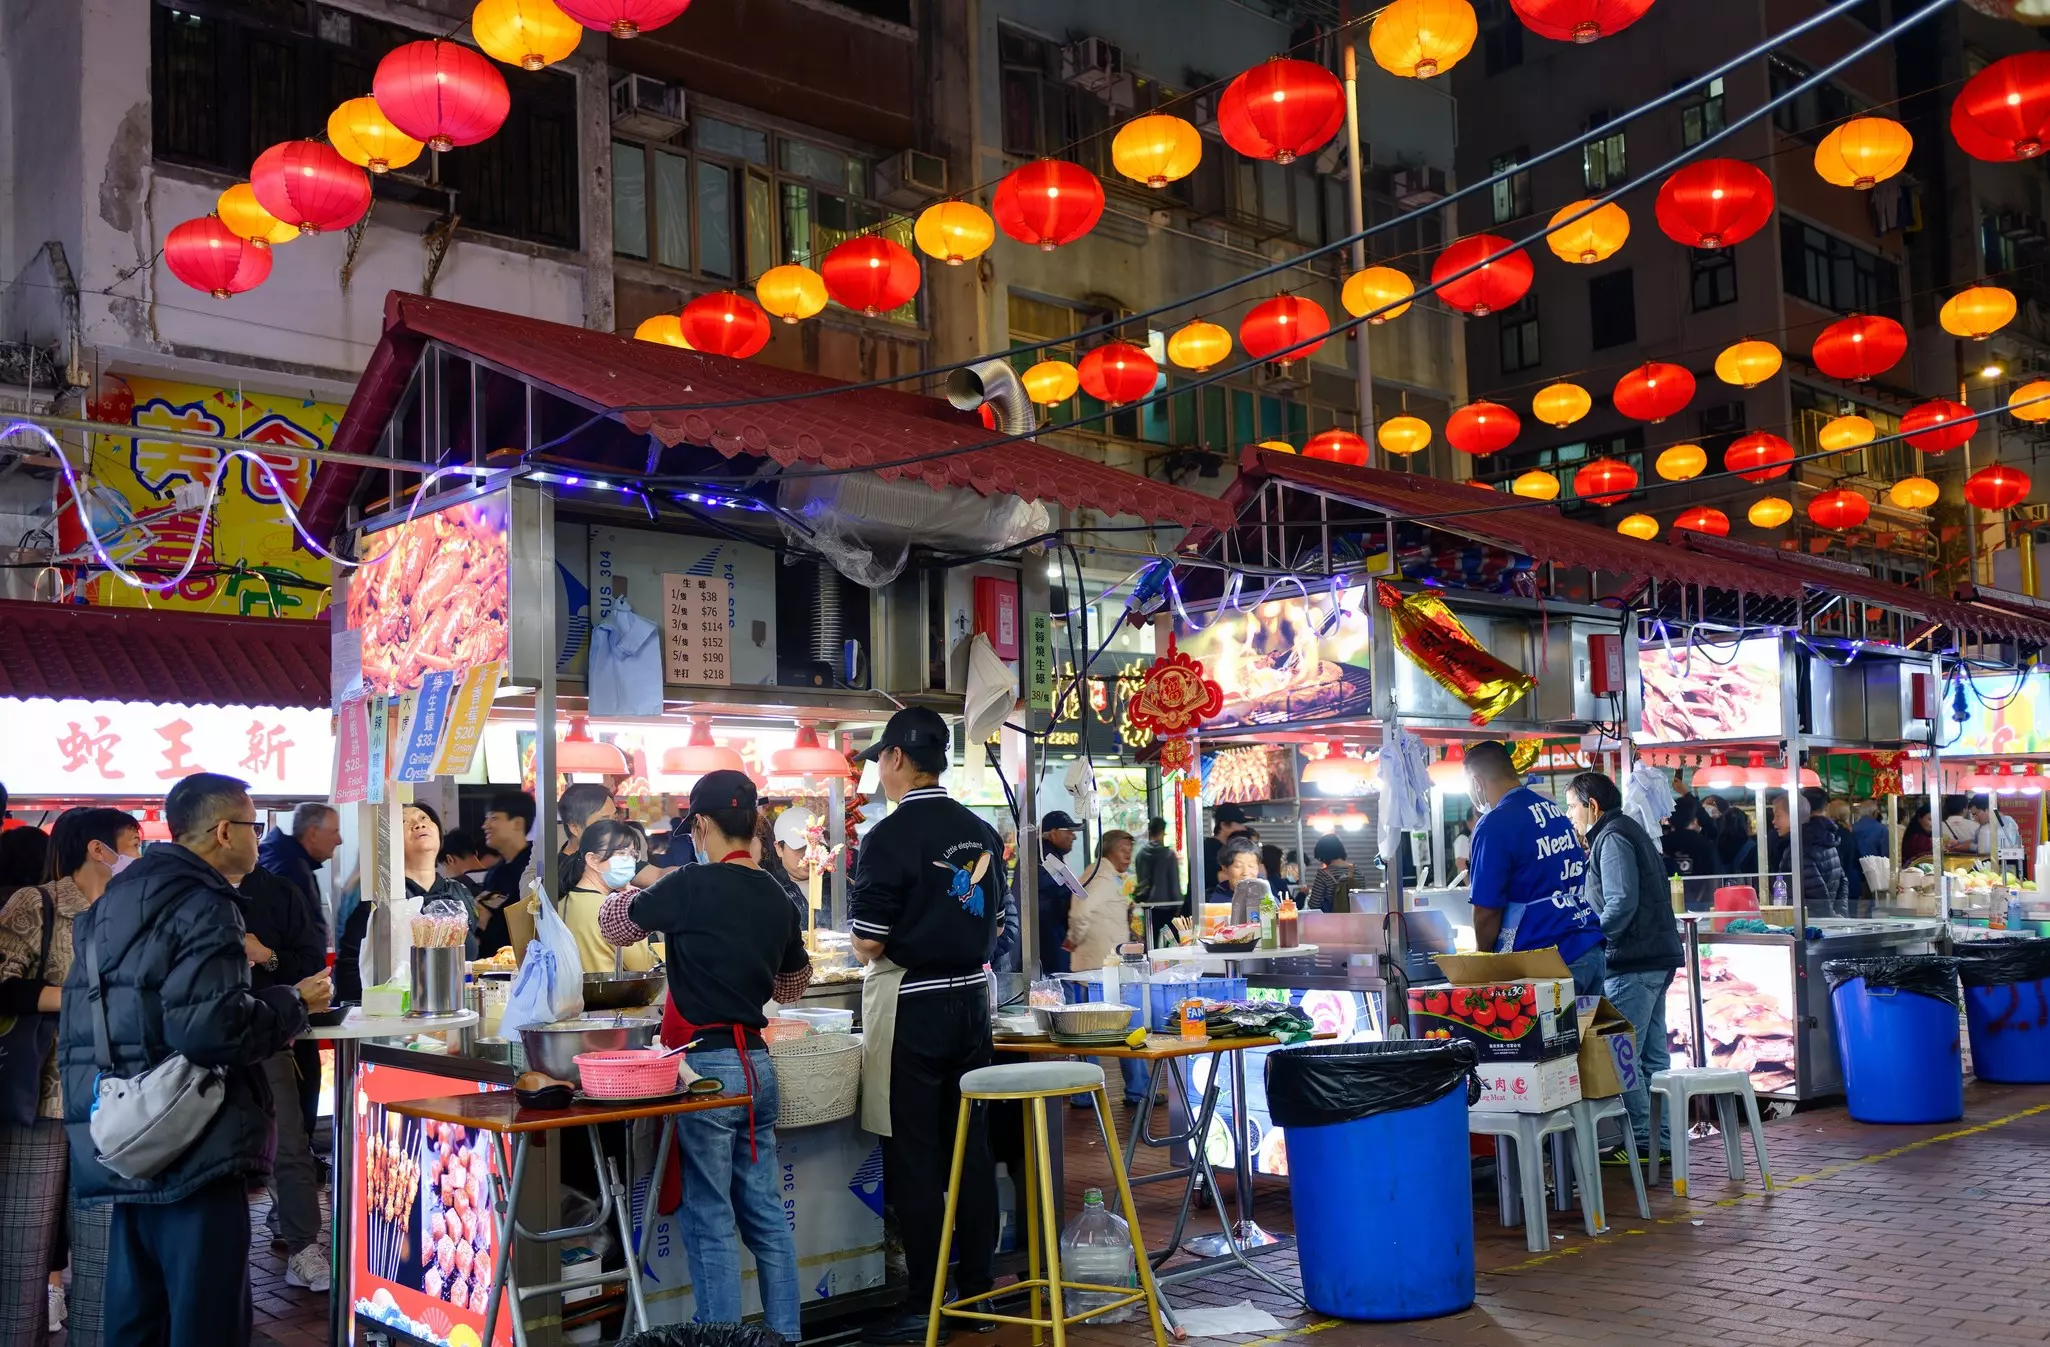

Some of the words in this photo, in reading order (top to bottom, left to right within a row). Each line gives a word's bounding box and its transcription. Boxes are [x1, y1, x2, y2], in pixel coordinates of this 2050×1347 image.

[131, 398, 324, 512] 美食
[600, 550, 612, 578] 304
[600, 586, 612, 618] SUS
[671, 588, 687, 601] 1/隻
[701, 592, 718, 602] $38
[671, 604, 688, 616] 2/隻
[701, 606, 718, 617] $76
[671, 619, 689, 631] 3/隻
[702, 622, 723, 632] $114
[671, 634, 689, 647] 4/隻
[702, 637, 724, 648] $152
[672, 650, 689, 662] 5/隻
[702, 652, 724, 664] $190
[673, 668, 689, 678] 半打
[703, 669, 725, 680] $218
[416, 733, 432, 748] $38
[454, 725, 475, 741] $20
[56, 715, 295, 781] 蛇王新
[344, 757, 360, 773] $28
[409, 752, 433, 766] Grilled
[347, 775, 363, 787] Fried
[1528, 802, 1547, 829] If
[943, 845, 958, 859] Little
[958, 841, 983, 851] elephant
[1536, 829, 1575, 860] Need
[1560, 859, 1584, 881] Jus
[783, 1163, 794, 1191] 304
[657, 1222, 670, 1258] SUS
